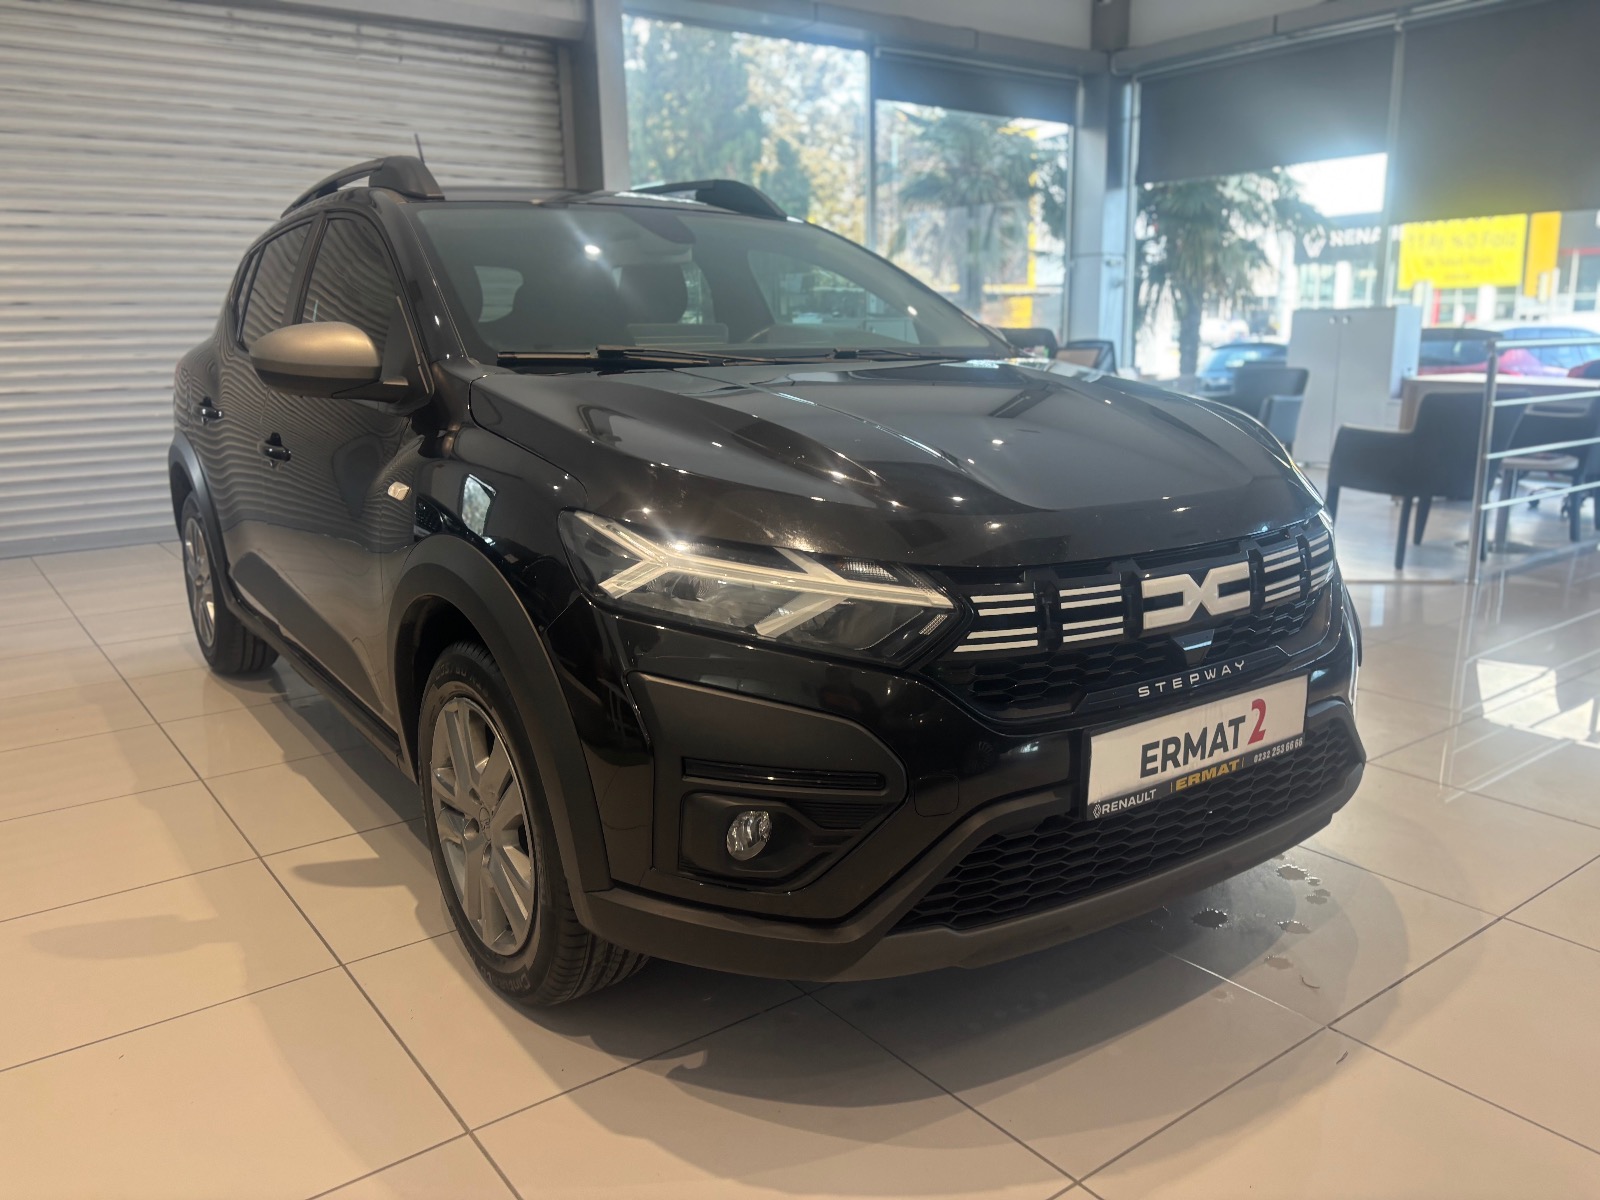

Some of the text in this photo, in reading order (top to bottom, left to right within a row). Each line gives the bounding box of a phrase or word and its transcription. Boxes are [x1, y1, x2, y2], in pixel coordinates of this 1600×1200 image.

[1138, 660, 1245, 698] STEPWAY
[1253, 750, 1271, 763] 0232
[1272, 744, 1285, 757] 253
[1175, 759, 1241, 791] ERMAT
[1101, 788, 1157, 815] RENAULT
